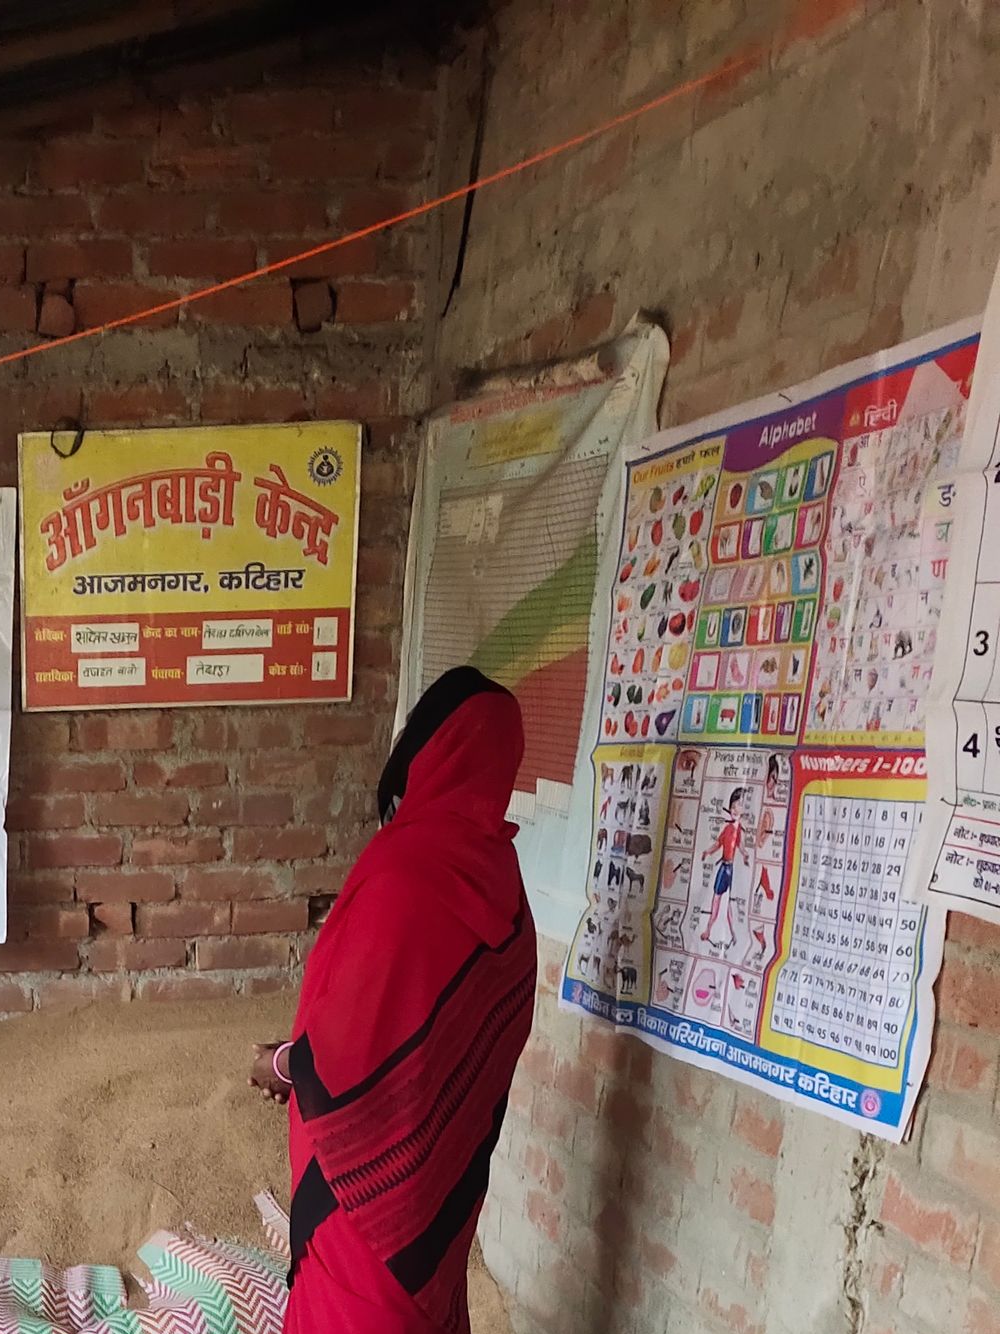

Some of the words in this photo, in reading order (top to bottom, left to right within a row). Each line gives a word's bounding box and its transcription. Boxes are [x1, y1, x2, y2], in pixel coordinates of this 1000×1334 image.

[759, 411, 818, 448] Alphabet
[40, 451, 241, 572] आँगनबाड़ी
[254, 464, 339, 565] केन्द्र
[73, 572, 209, 594] आजमनगर,
[219, 562, 305, 591] कटिहार
[165, 627, 177, 638] का
[973, 630, 990, 656] 3
[962, 732, 980, 758] 4
[800, 755, 870, 773] Numbers
[872, 757, 927, 775] 1-100
[842, 807, 847, 818] 5
[855, 808, 860, 819] 6
[867, 809, 872, 819] 7
[881, 810, 888, 821] 8
[900, 811, 908, 822] 9
[836, 833, 845, 844] 15
[851, 833, 859, 845] 16
[875, 837, 885, 848] 18
[893, 838, 905, 849] 19
[833, 858, 843, 870] 25
[847, 860, 857, 871] 26
[872, 863, 881, 874] 28
[887, 865, 901, 876] 29
[831, 883, 840, 894] 35
[844, 885, 855, 896] 36
[859, 887, 867, 898] 37
[870, 888, 878, 900] 38
[882, 891, 896, 902] 39
[828, 909, 838, 919] 45
[842, 910, 852, 921] 46
[855, 912, 866, 924] 47
[879, 916, 893, 929] 49
[900, 921, 917, 931] 50
[827, 933, 836, 944] 55
[840, 935, 849, 947] 56
[853, 938, 863, 951] 57
[866, 940, 875, 952] 58
[878, 942, 888, 955] 59
[896, 946, 913, 958] 60
[834, 961, 845, 971] 66
[847, 963, 858, 975] 67
[859, 965, 870, 976] 68
[872, 968, 885, 980] 69
[826, 980, 834, 992] 75
[837, 983, 845, 995] 76
[868, 993, 883, 1005] 79
[833, 1007, 843, 1020] 86
[867, 1018, 878, 1031] 89
[883, 1023, 898, 1035] 90
[817, 1027, 826, 1040] 95
[830, 1030, 840, 1043] 96
[843, 1035, 852, 1048] 97
[865, 1042, 876, 1055] 99
[879, 1047, 897, 1061] 100
[637, 1007, 668, 1036] विकास
[670, 1022, 727, 1058] परियोजना
[727, 1045, 797, 1086] आजमनगर
[797, 1073, 858, 1109] कटिहार
